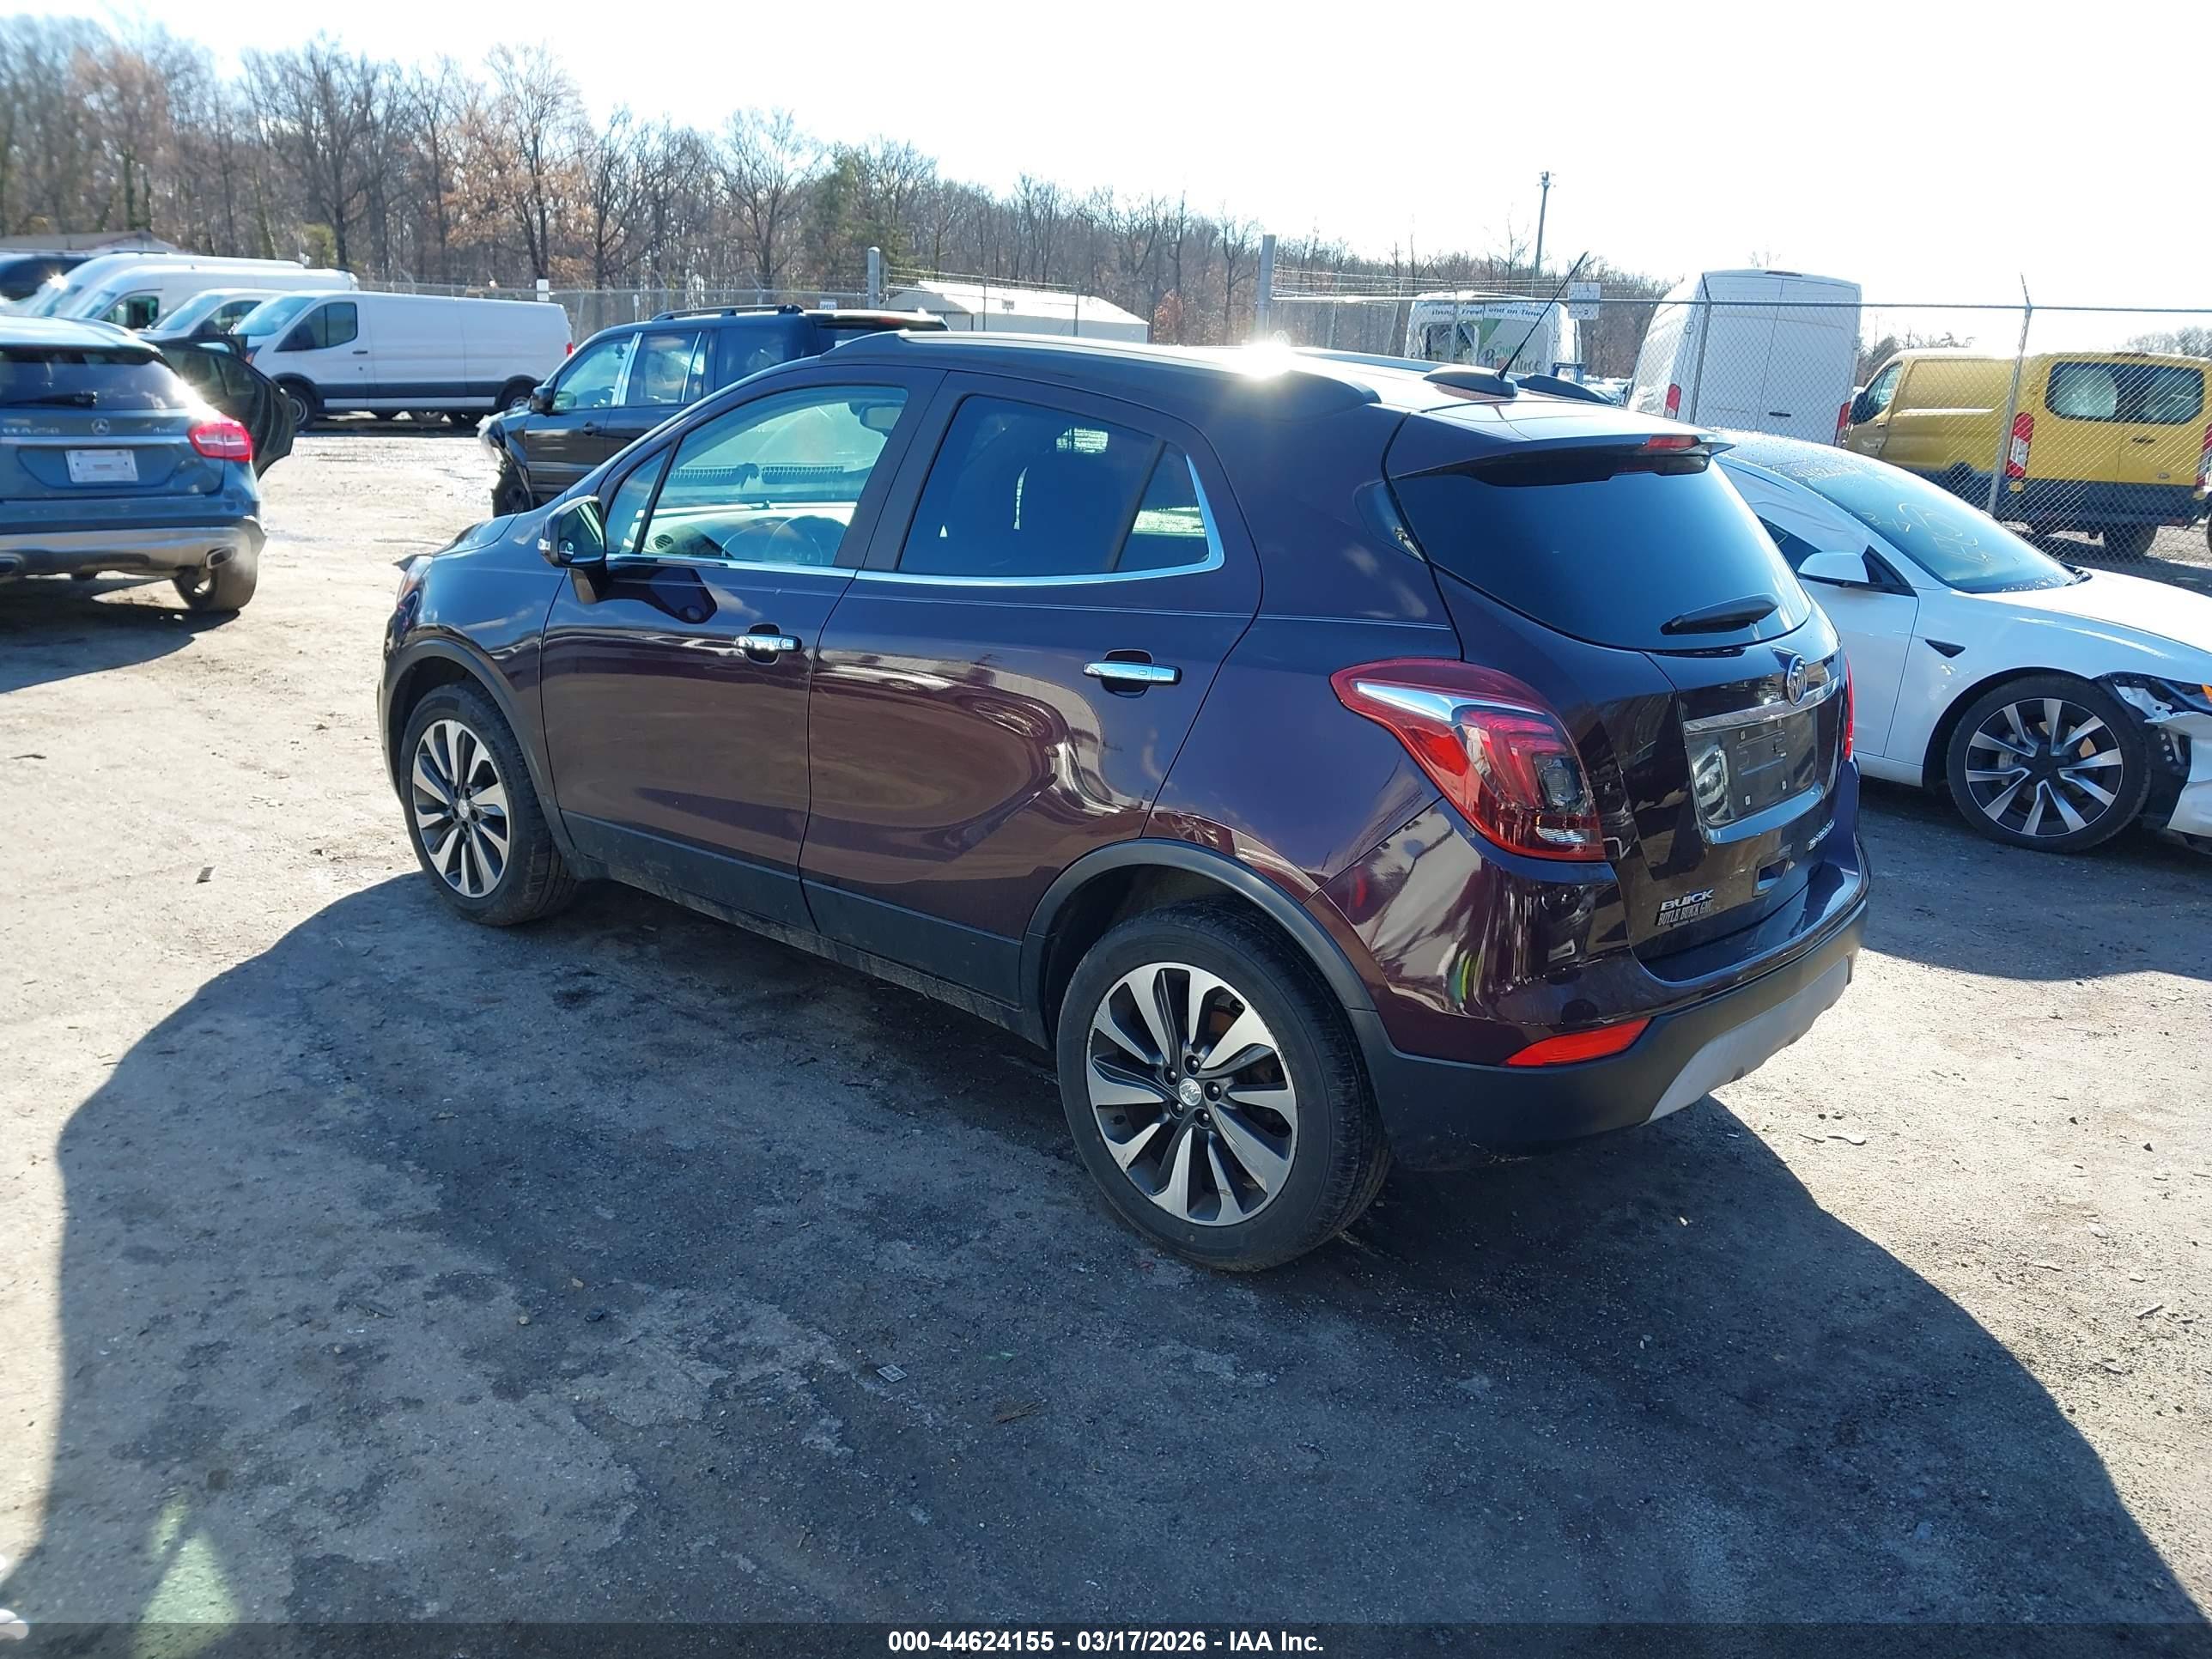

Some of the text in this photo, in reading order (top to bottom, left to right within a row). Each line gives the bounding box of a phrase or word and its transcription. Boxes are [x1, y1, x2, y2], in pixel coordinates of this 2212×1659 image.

[1661, 889, 1714, 911] BUICK
[1657, 908, 1680, 926] BOYLE
[1680, 902, 1700, 921] BUICK
